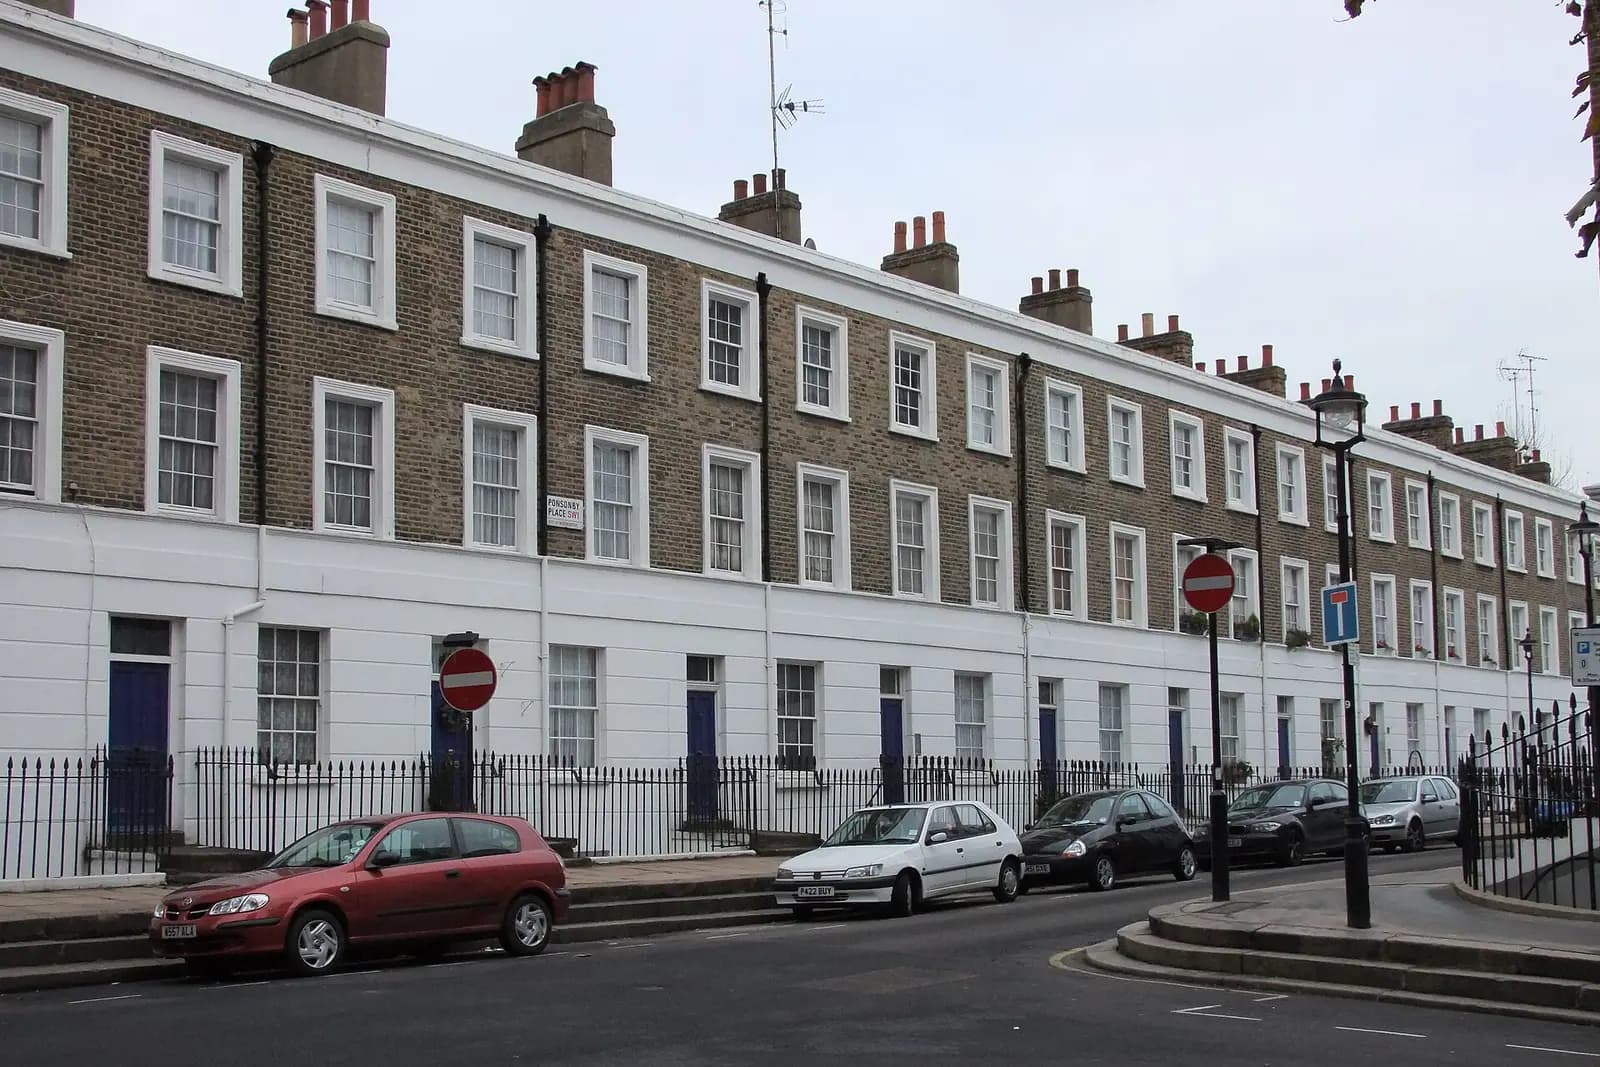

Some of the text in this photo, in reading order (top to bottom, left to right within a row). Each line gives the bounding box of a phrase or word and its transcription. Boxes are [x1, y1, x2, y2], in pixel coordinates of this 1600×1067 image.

[548, 498, 580, 510] PONSONBY
[548, 507, 567, 518] PLACE
[1579, 642, 1588, 653] P
